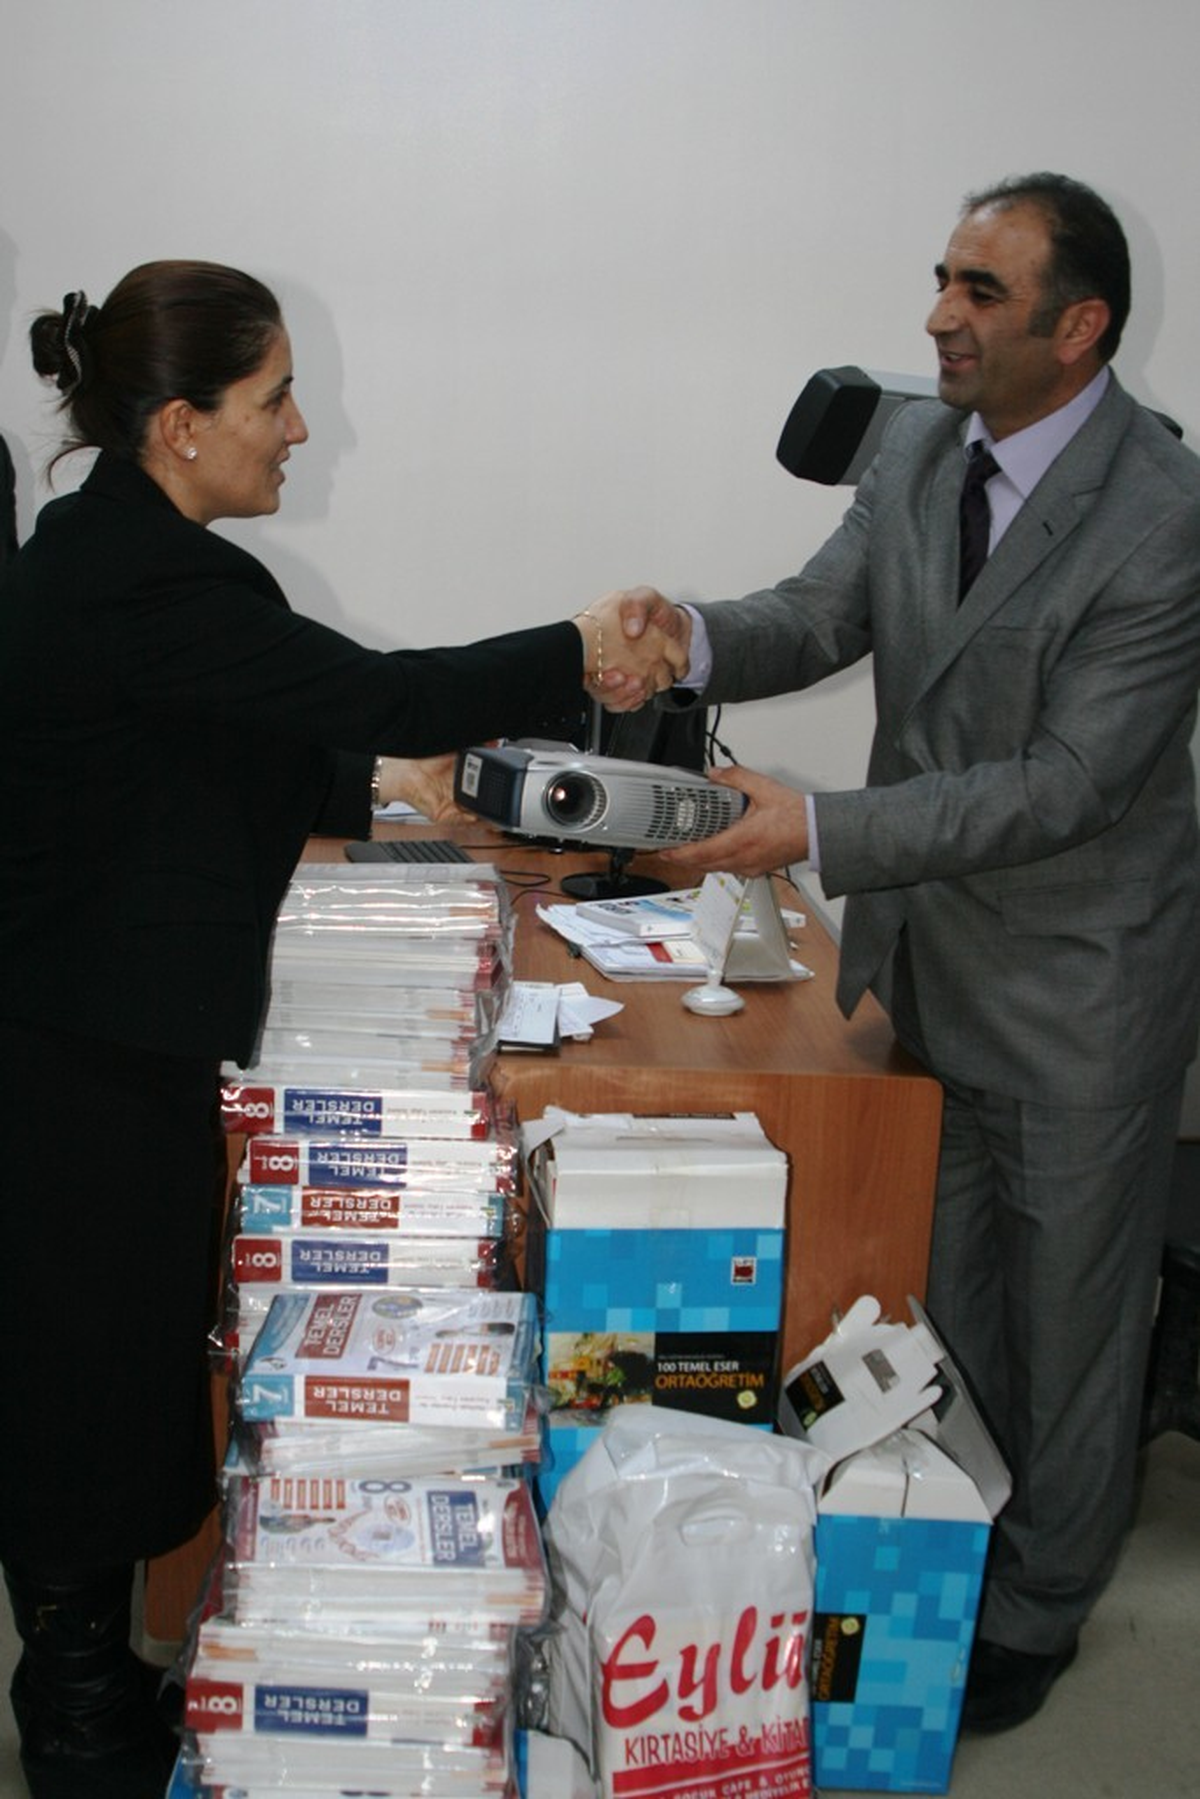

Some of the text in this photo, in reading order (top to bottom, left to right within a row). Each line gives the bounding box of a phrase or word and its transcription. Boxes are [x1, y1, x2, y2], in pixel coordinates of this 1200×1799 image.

[245, 1102, 270, 1119] 8
[292, 1099, 375, 1113] DERSLER
[305, 1111, 363, 1125] TEMEL
[269, 1155, 294, 1172] 8
[317, 1151, 399, 1165] DERSLER
[253, 1194, 282, 1214] 7
[310, 1196, 392, 1210] DERSLER
[322, 1209, 380, 1222] TEMEL
[252, 1252, 277, 1268] 8
[300, 1249, 381, 1262] DERSLER
[311, 1261, 370, 1274] TEMEL
[304, 1303, 334, 1345] TEMEL
[322, 1295, 357, 1355] DERSLER
[657, 1360, 739, 1373] 100 TEMEL ESER
[252, 1383, 283, 1403] 7
[313, 1385, 401, 1402] DERSLER
[325, 1400, 389, 1415] TEMEL
[358, 1480, 412, 1494] 8
[431, 1494, 456, 1562] DERSLER
[455, 1503, 478, 1552] TEMEL
[208, 1695, 237, 1715] 8
[264, 1694, 360, 1713] DERSLER
[277, 1709, 347, 1726] TEMEL
[625, 1723, 728, 1766] KIRTASİYE
[736, 1725, 755, 1758] &
